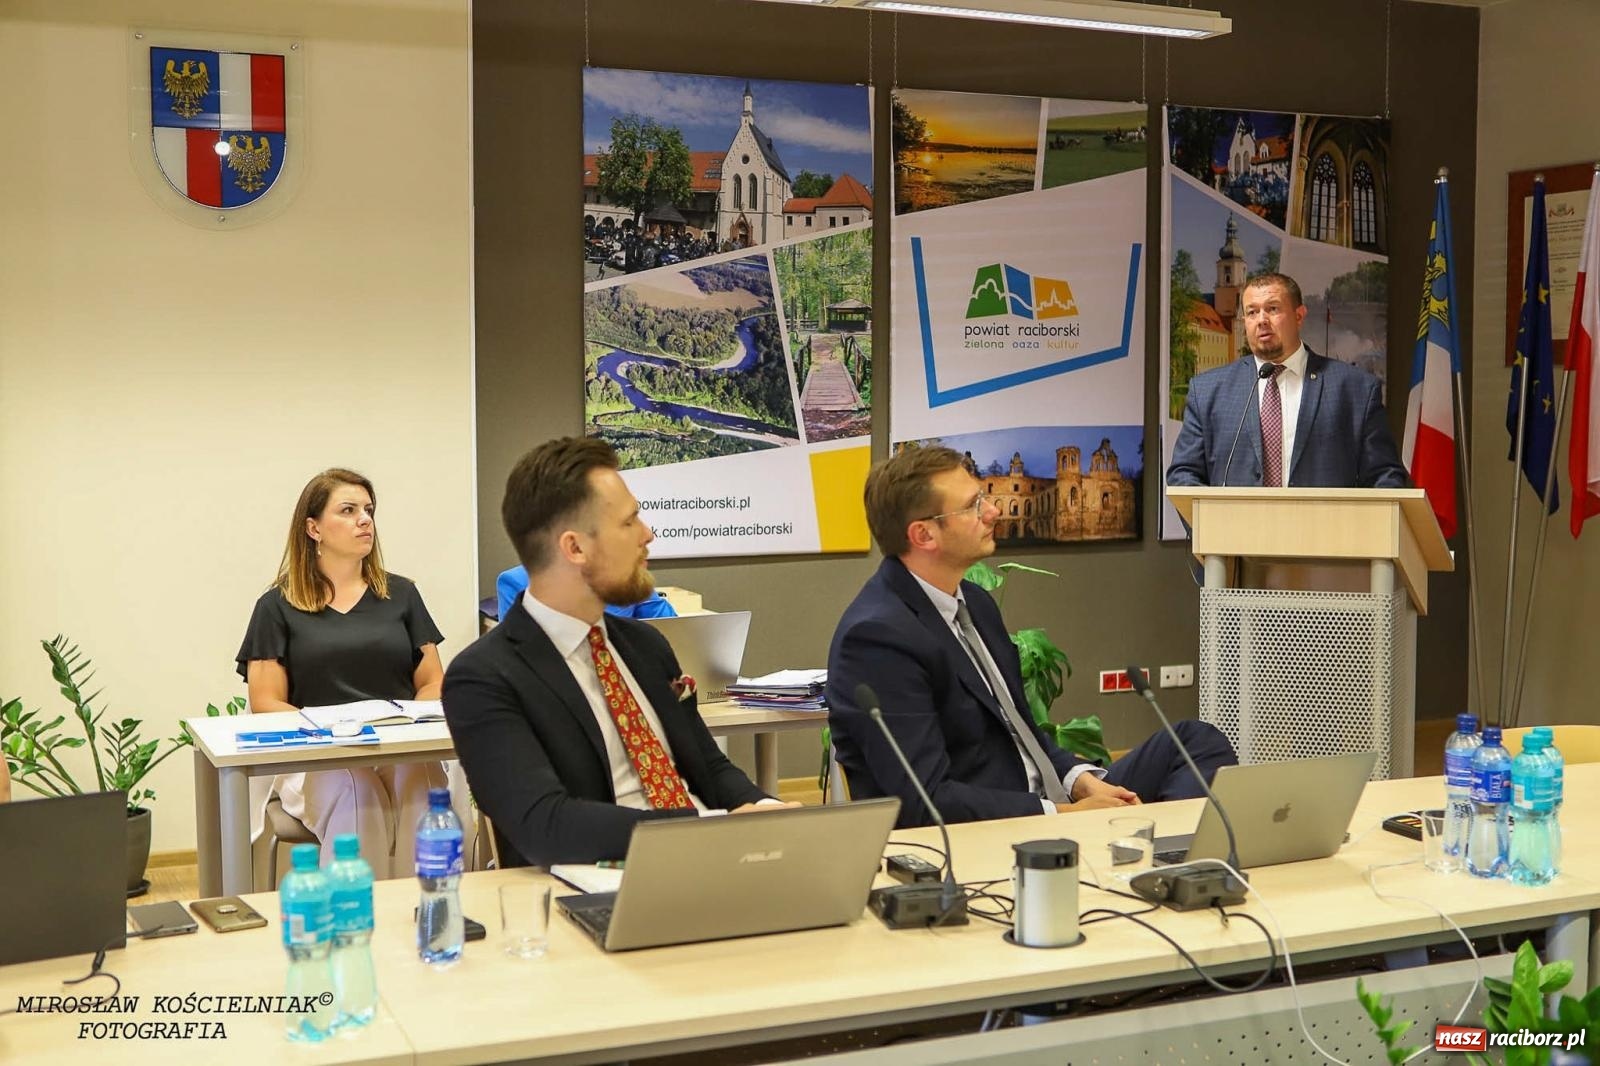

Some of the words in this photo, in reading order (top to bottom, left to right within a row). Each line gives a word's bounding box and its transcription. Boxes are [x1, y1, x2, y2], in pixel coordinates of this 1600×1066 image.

[964, 322, 1010, 340] powiat
[1018, 322, 1080, 337] raciborski
[964, 339, 1005, 349] zielona
[1012, 340, 1040, 349] oaza
[1047, 339, 1080, 350] kultur
